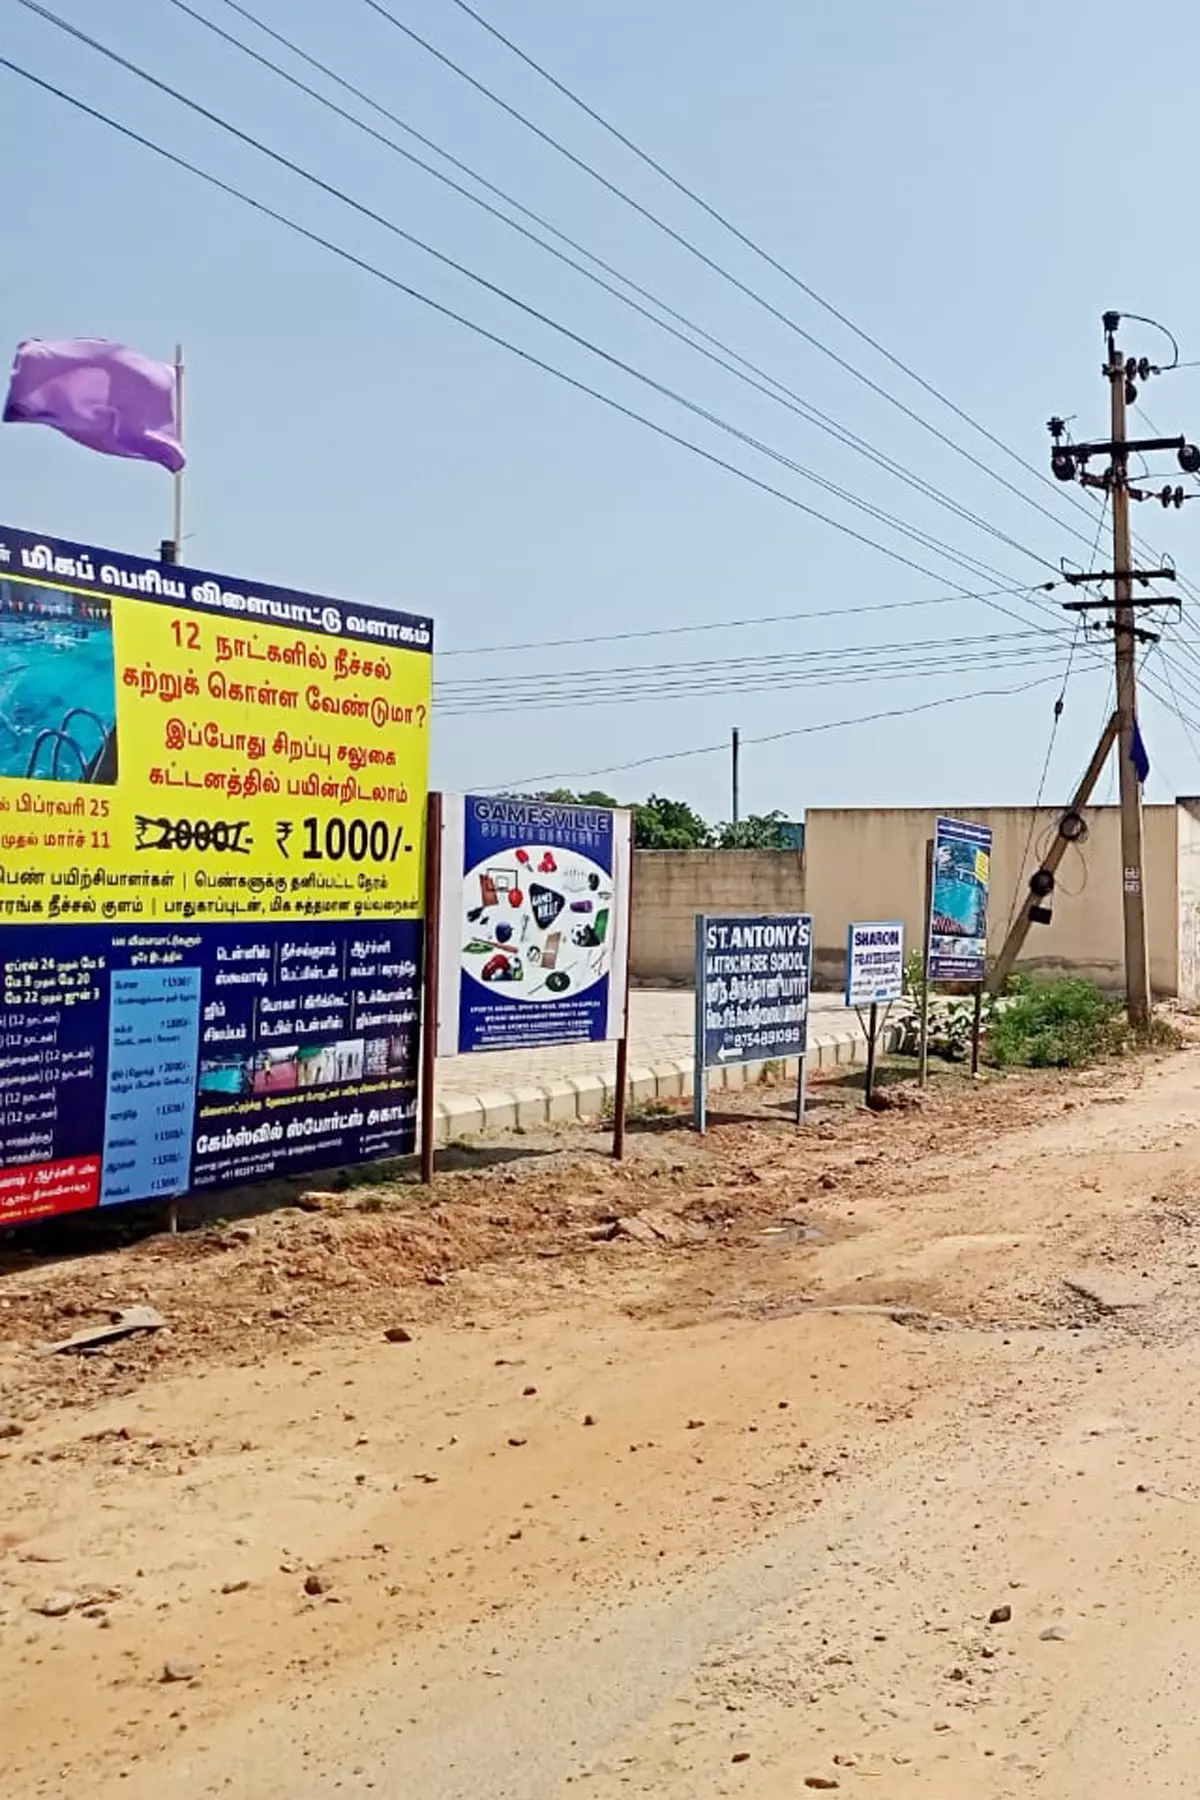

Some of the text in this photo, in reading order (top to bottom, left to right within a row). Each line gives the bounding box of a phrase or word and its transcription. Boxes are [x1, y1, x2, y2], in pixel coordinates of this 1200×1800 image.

[21, 545, 95, 581] மிகப்
[101, 565, 186, 599] பெரிய
[192, 581, 342, 632] விளையாட்டு
[347, 615, 430, 644] வளாகம்
[170, 619, 392, 681] 12 நாட்களில் நீச்சல்
[122, 661, 200, 702] கற்றுக்
[208, 671, 298, 709] கொள்ள
[165, 718, 396, 771] இப்போது சிறப்பு சலுகை
[16, 793, 85, 817] பிப்ரவரி
[90, 799, 110, 817] 25
[474, 799, 610, 833] GAMESVILLE
[44, 829, 86, 847] மார்ச்
[91, 831, 111, 849] 11
[195, 869, 287, 893] பெண்களுக்கு
[48, 894, 96, 918] நீச்சல்
[101, 896, 143, 918] குளம்
[855, 931, 900, 947] SHARON
[770, 952, 807, 972] SCHOOL
